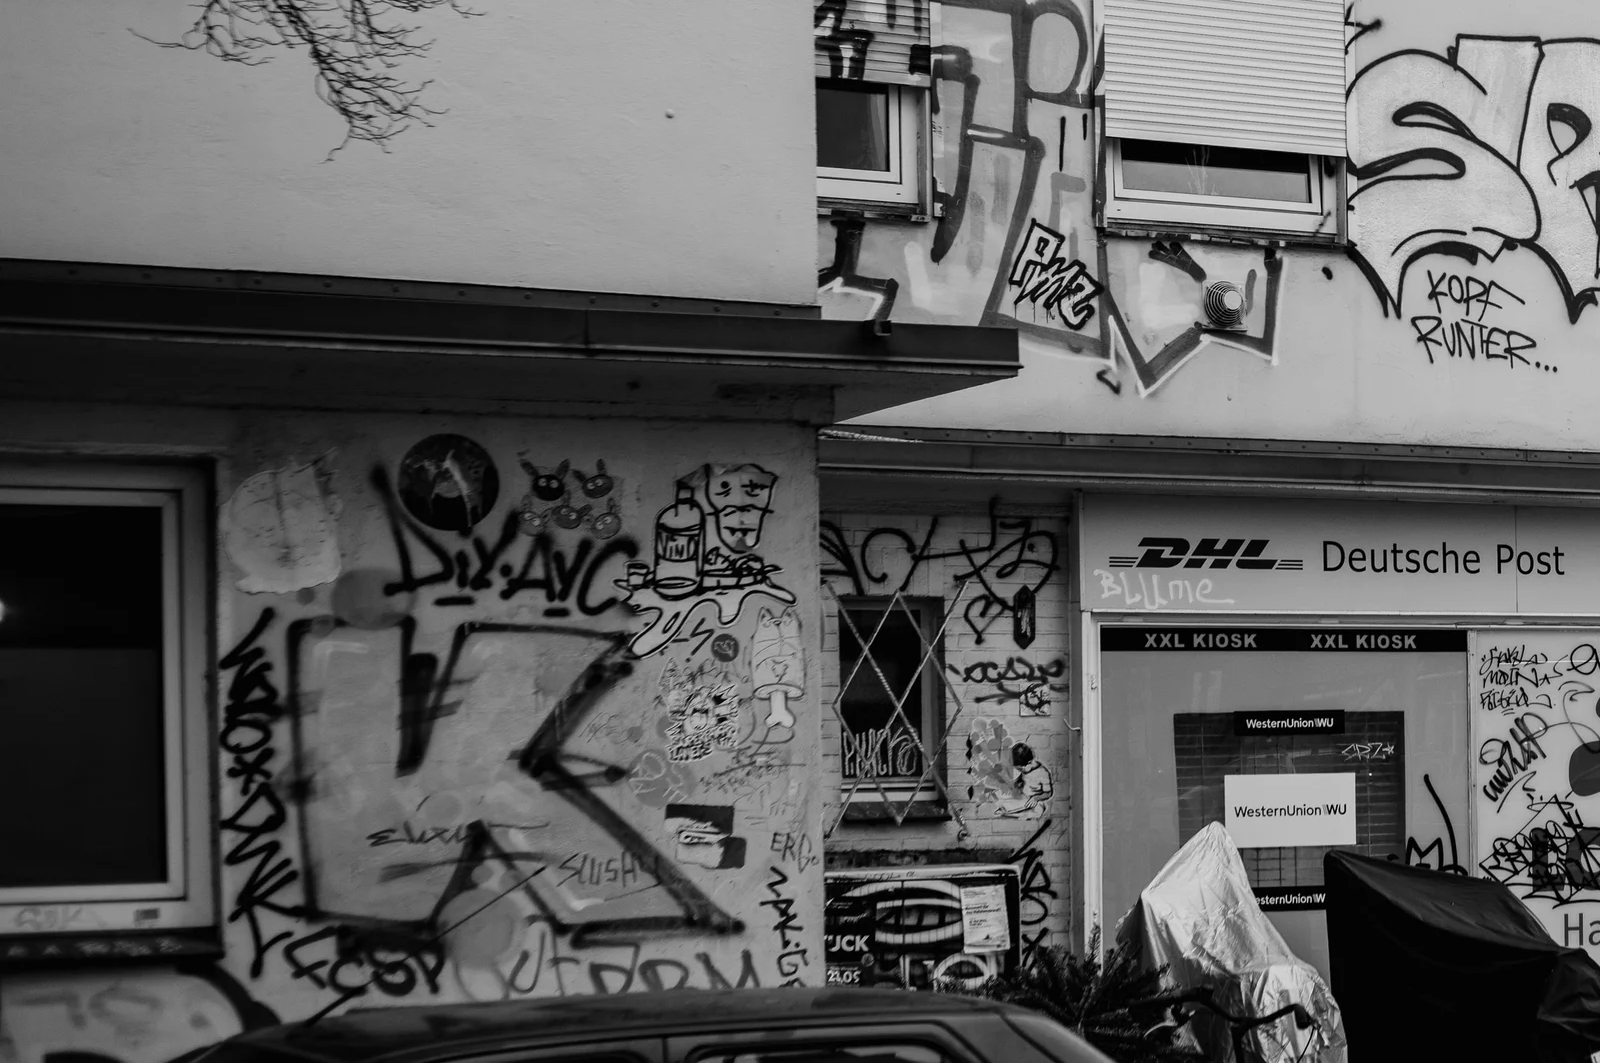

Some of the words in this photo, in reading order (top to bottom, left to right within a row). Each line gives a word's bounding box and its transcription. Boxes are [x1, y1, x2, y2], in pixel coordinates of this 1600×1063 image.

[1427, 270, 1525, 321] KOPF
[1136, 537, 1278, 570] DHL
[1322, 540, 1480, 575] Deutsche
[1497, 544, 1565, 575] Post
[1144, 633, 1185, 649] XXL
[1193, 633, 1258, 649] KIOSK
[1310, 634, 1348, 649] XXL
[1355, 634, 1417, 650] KIOSK
[1255, 894, 1312, 906] esternUnion
